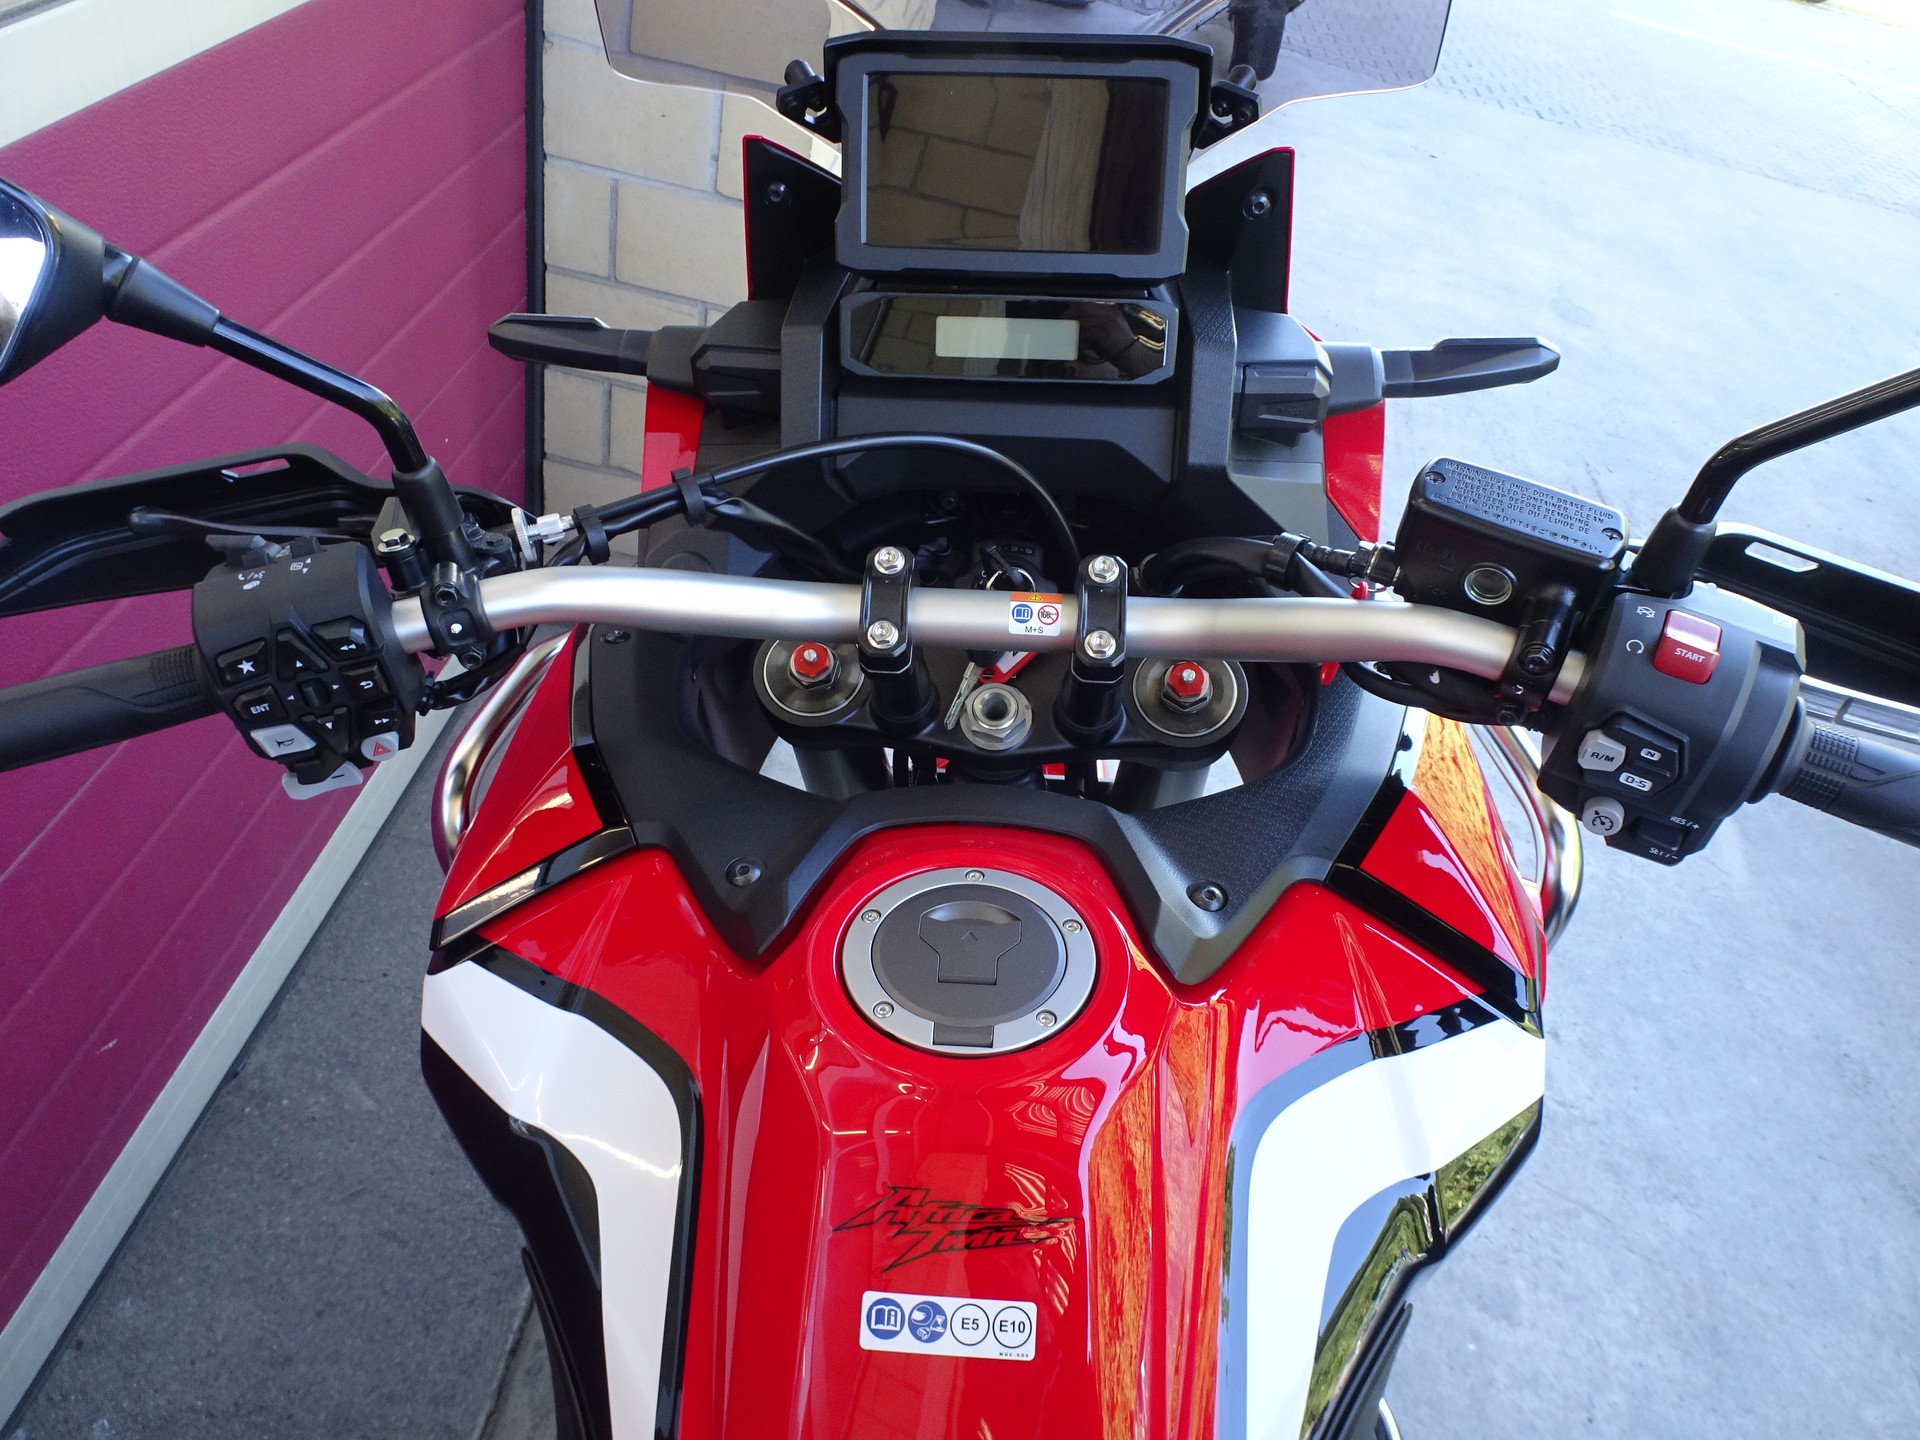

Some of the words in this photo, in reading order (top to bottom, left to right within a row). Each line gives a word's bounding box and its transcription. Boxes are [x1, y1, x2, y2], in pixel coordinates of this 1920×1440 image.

[1449, 470, 1474, 483] FROM
[1483, 480, 1518, 497] SEALED
[1520, 492, 1571, 513] CONTAINER.
[1573, 509, 1604, 524] CLEAN
[1449, 491, 1477, 505] FREIN
[1455, 479, 1487, 494] FILLER
[1488, 489, 1506, 500] CAP
[1508, 495, 1542, 511] BEFORE
[1544, 507, 1592, 527] REMOVING.
[1489, 475, 1506, 485] USE
[1508, 481, 1530, 493] ONLY
[1532, 489, 1554, 501] DOT4
[1556, 496, 1585, 511] BRAKE
[1587, 506, 1614, 520] FLUID
[1506, 502, 1524, 513] QUE
[1527, 509, 1540, 518] DU
[1542, 513, 1575, 529] FLUIDE
[1577, 524, 1590, 534] DE
[1025, 626, 1044, 634] M+S
[1674, 648, 1705, 663] START
[250, 703, 270, 714] ENT
[1591, 752, 1615, 762] R/M
[1626, 776, 1648, 788] D-S
[961, 1317, 980, 1331] E5
[999, 1320, 1026, 1334] E10
